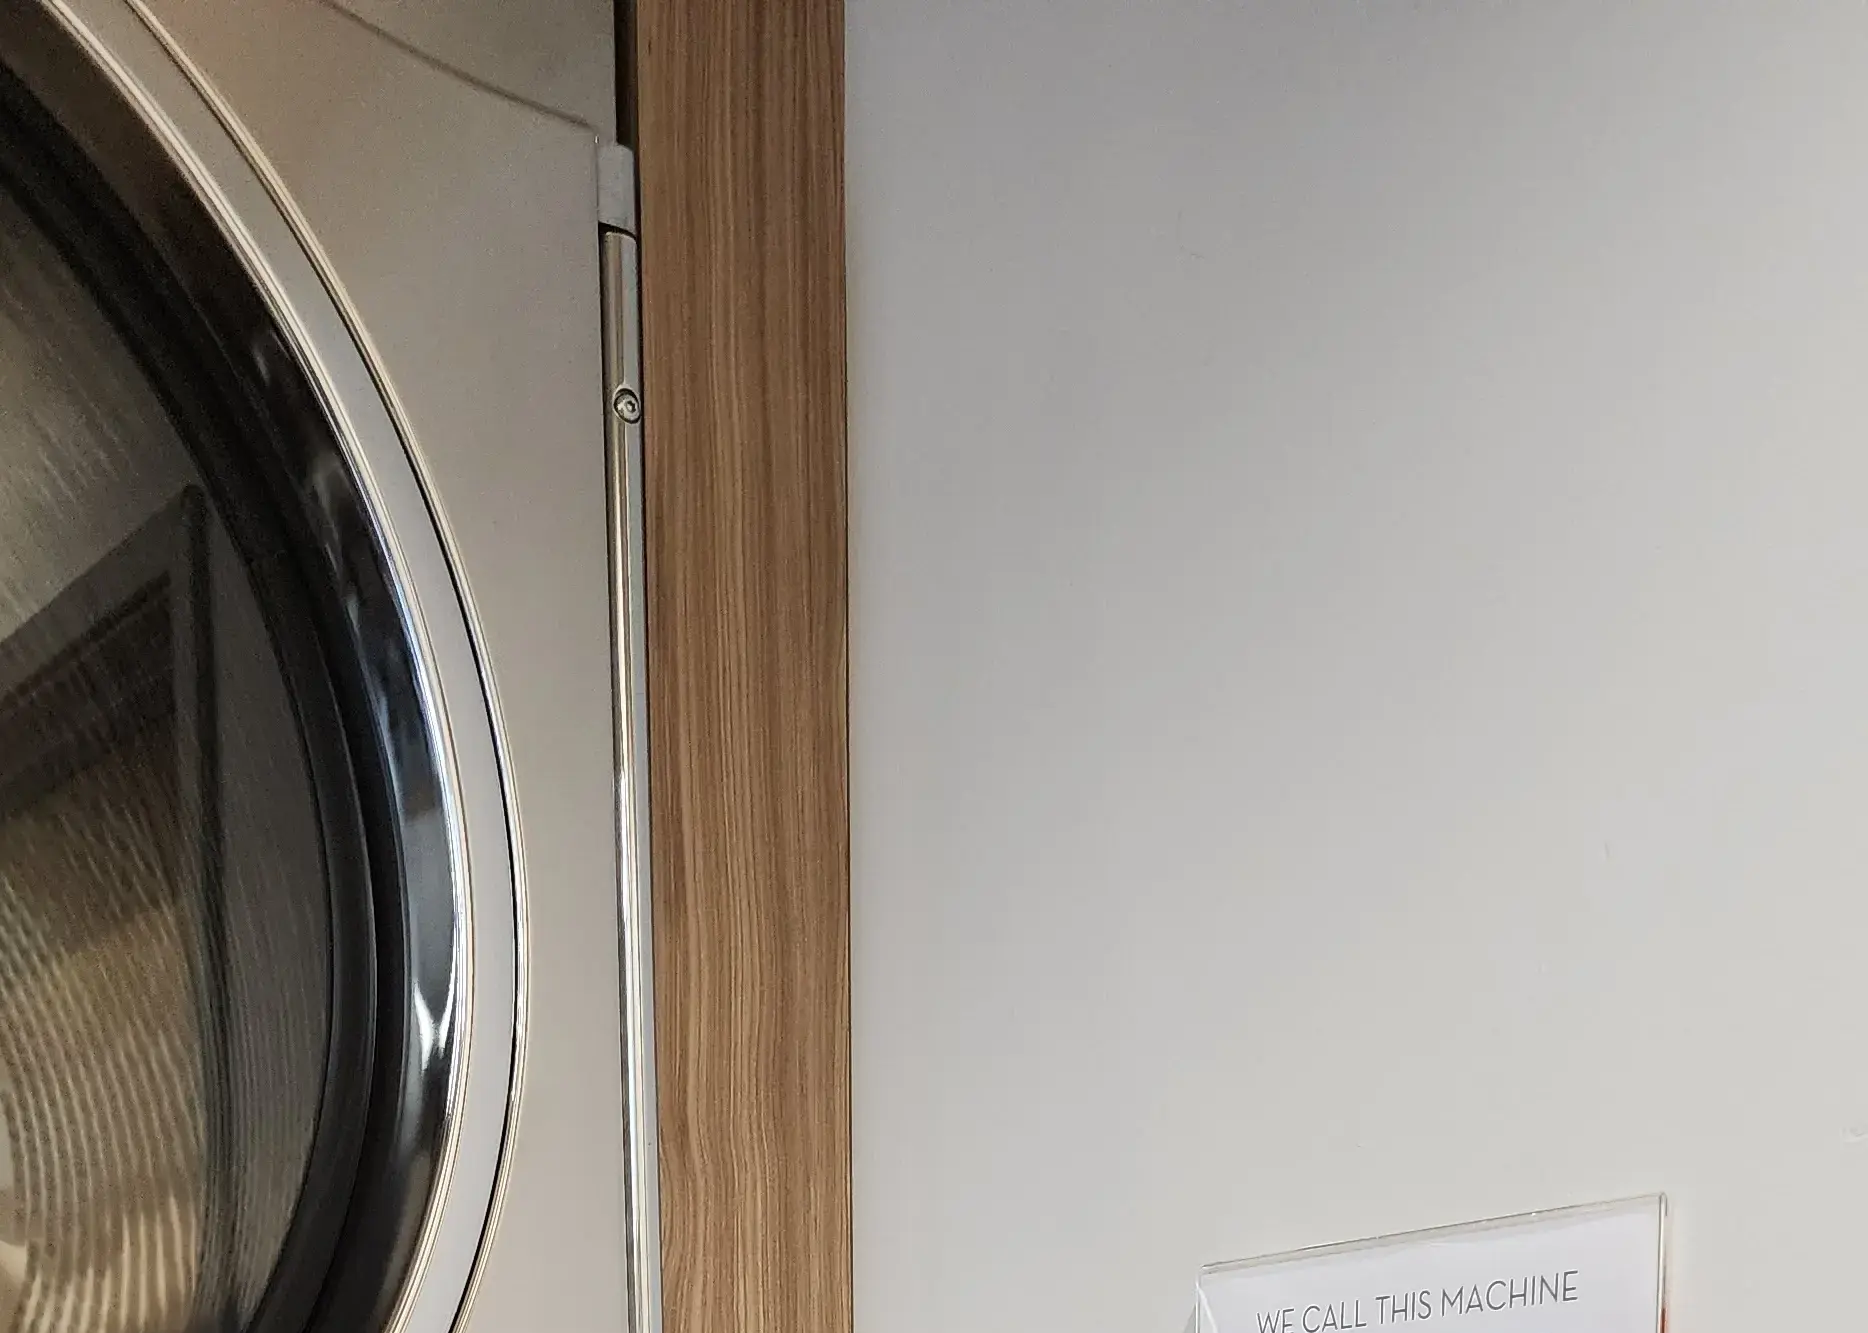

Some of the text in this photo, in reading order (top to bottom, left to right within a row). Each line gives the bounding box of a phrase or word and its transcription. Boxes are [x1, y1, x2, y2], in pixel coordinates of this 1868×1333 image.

[1302, 1300, 1366, 1333] CALL
[1376, 1290, 1431, 1325] THIS
[1442, 1270, 1578, 1316] MACHINE
